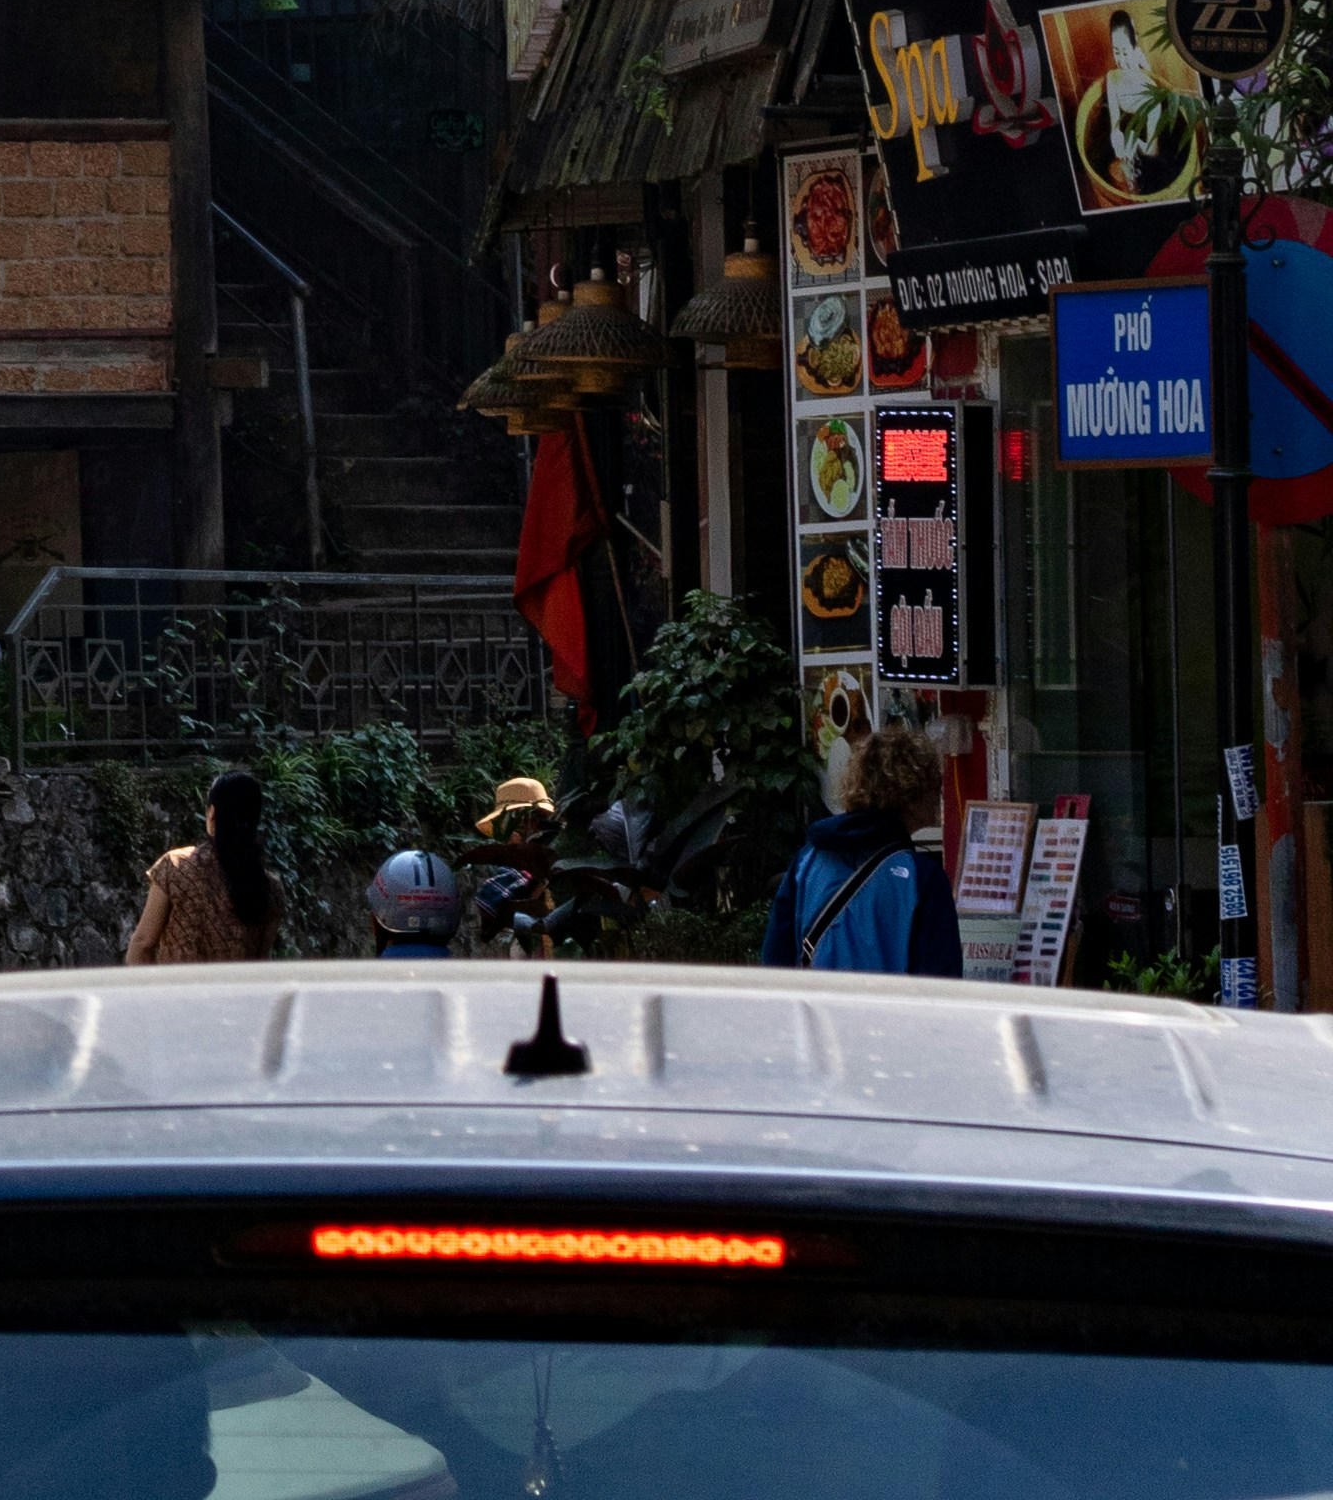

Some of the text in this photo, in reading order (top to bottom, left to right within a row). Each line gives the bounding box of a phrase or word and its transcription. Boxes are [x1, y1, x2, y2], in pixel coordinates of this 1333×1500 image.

[869, 10, 962, 182] Spa
[927, 272, 946, 308] 02
[997, 262, 1028, 300] HOA
[1113, 294, 1153, 352] PHỐ
[1157, 377, 1206, 434] HOA
